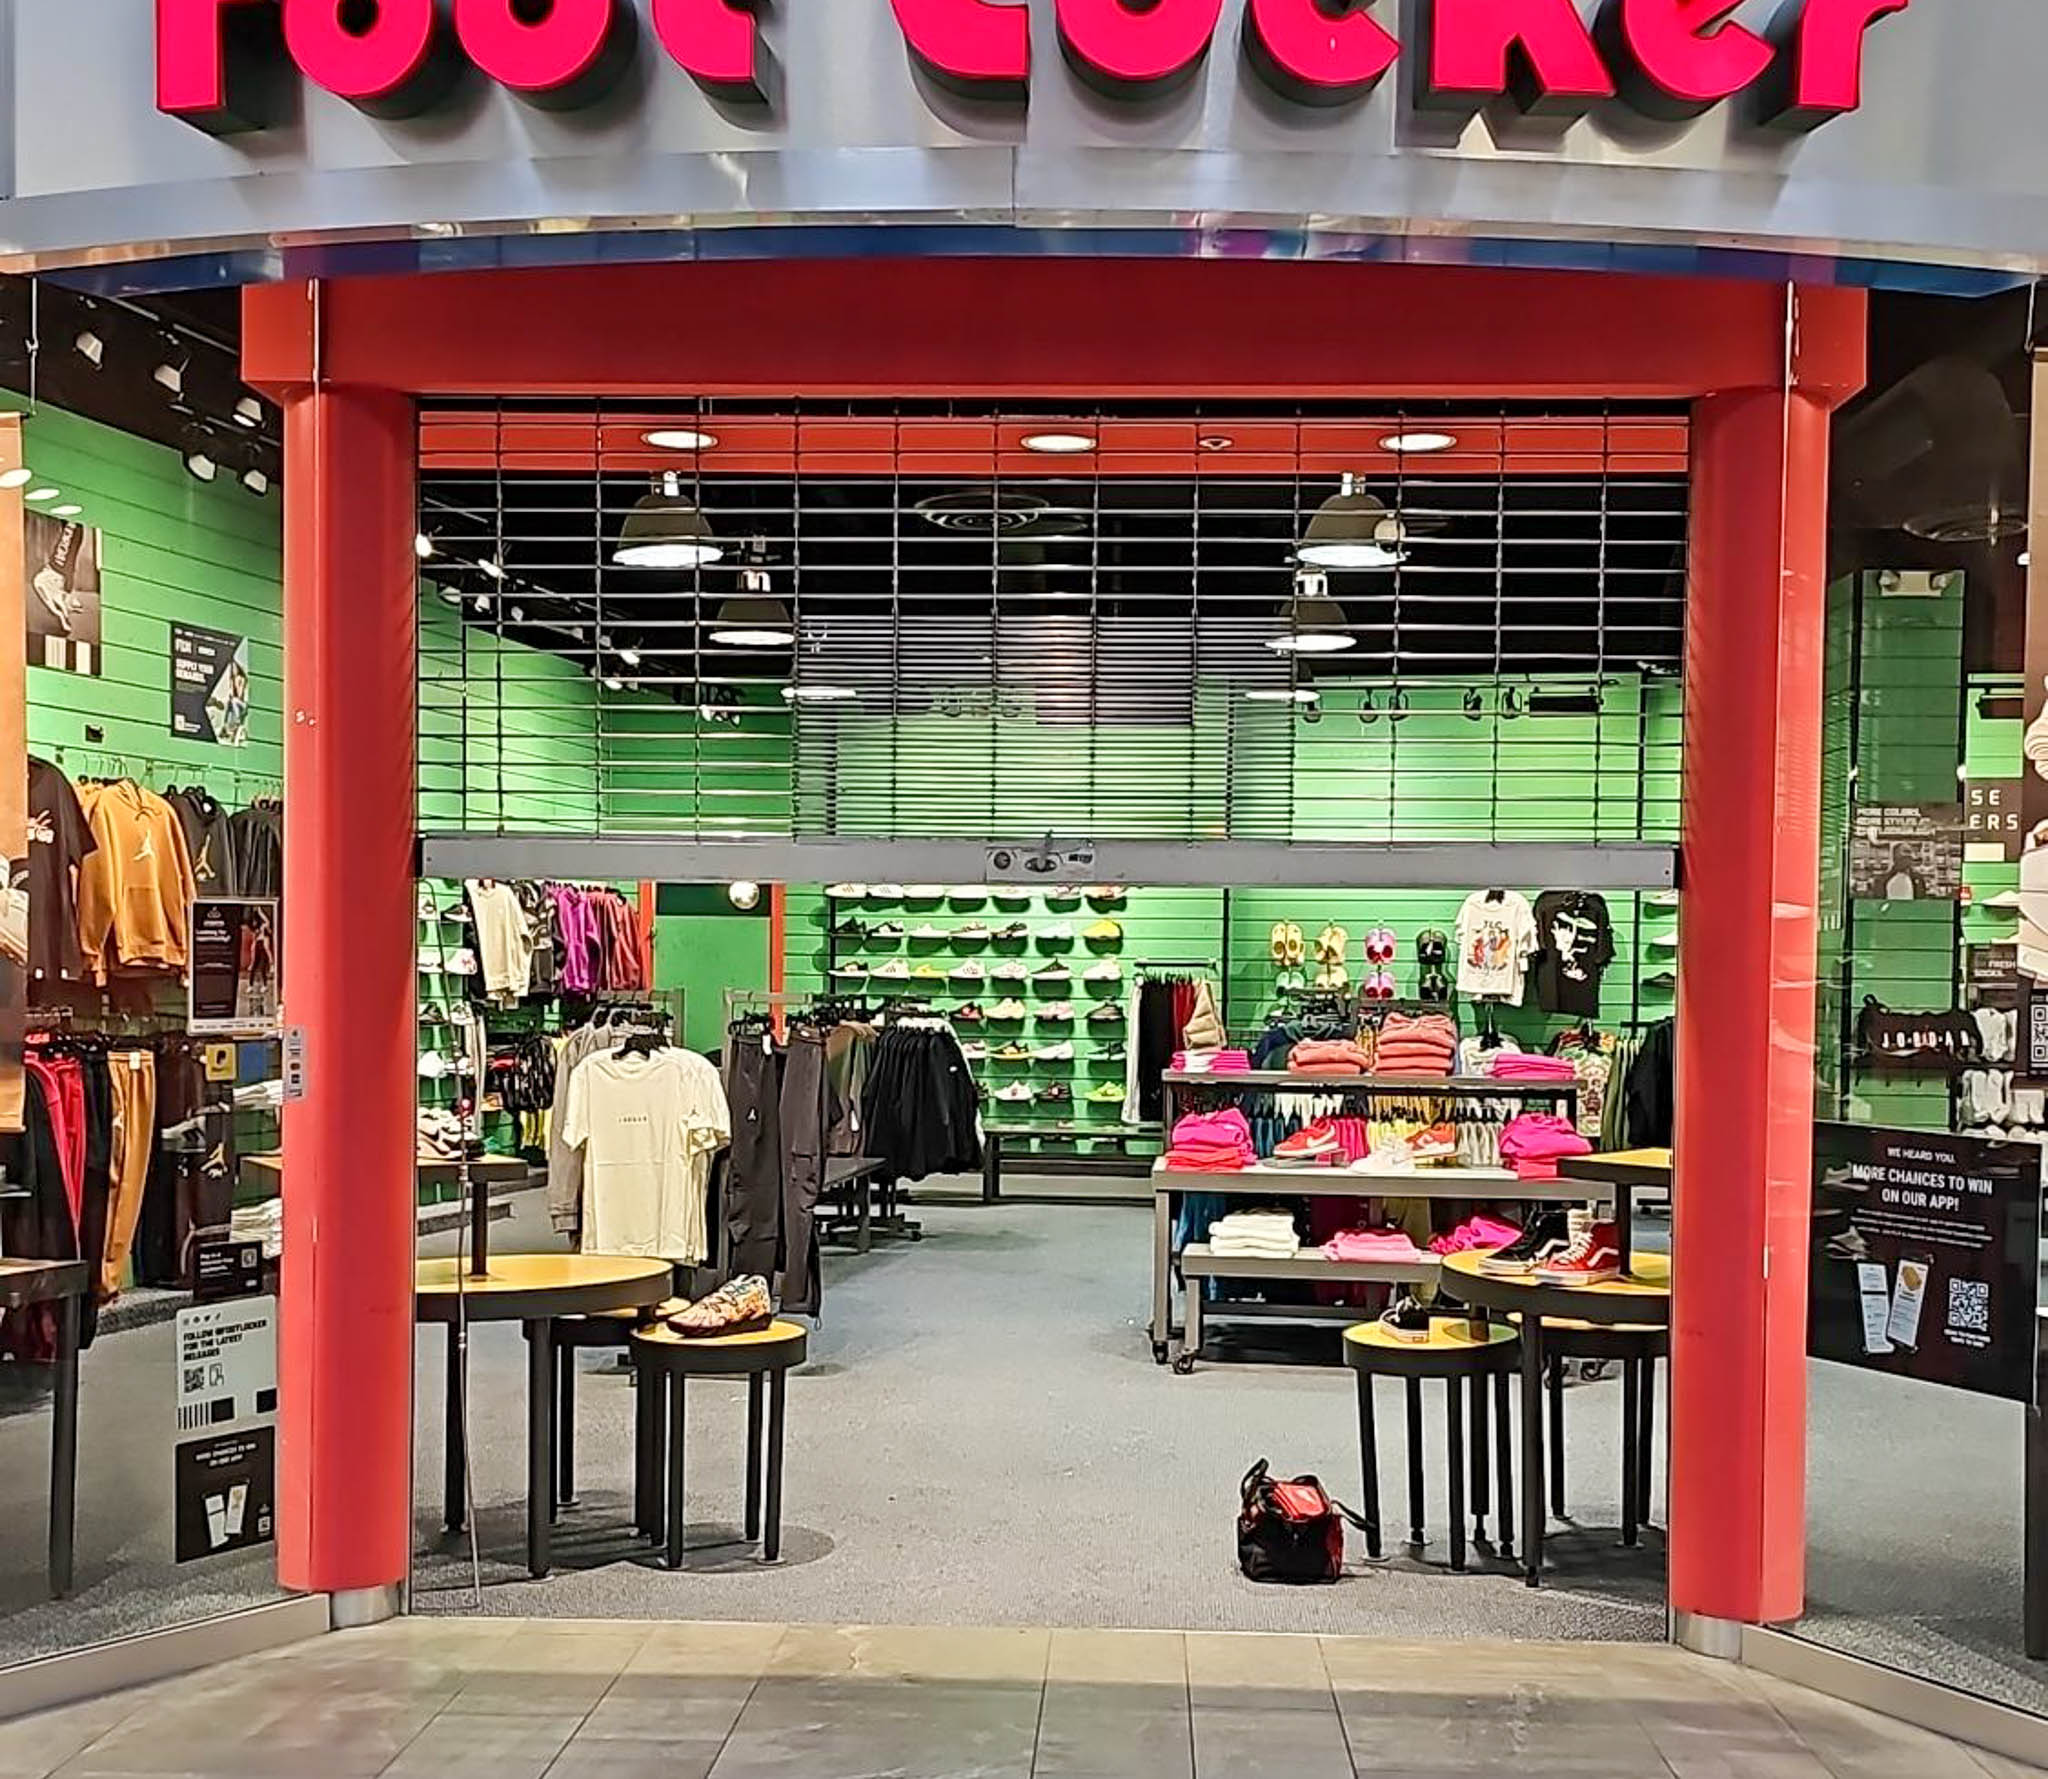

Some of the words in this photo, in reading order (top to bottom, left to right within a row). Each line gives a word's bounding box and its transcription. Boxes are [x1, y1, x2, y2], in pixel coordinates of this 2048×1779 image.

[1887, 1147, 1901, 1157] WE
[1902, 1149, 1932, 1161] HEARD
[1852, 1164, 1886, 1181] MORE
[1888, 1169, 1945, 1188] CHANCES
[1948, 1176, 1965, 1191] TO
[1967, 1178, 1992, 1194] WIN
[1881, 1188, 1900, 1203] ON
[1902, 1191, 1927, 1207] OUR
[1929, 1195, 1960, 1212] APP!
[183, 1329, 214, 1341] FOLLOW
[183, 1342, 198, 1352] FOR
[201, 1339, 214, 1347] THE
[216, 1333, 243, 1345] LATEST
